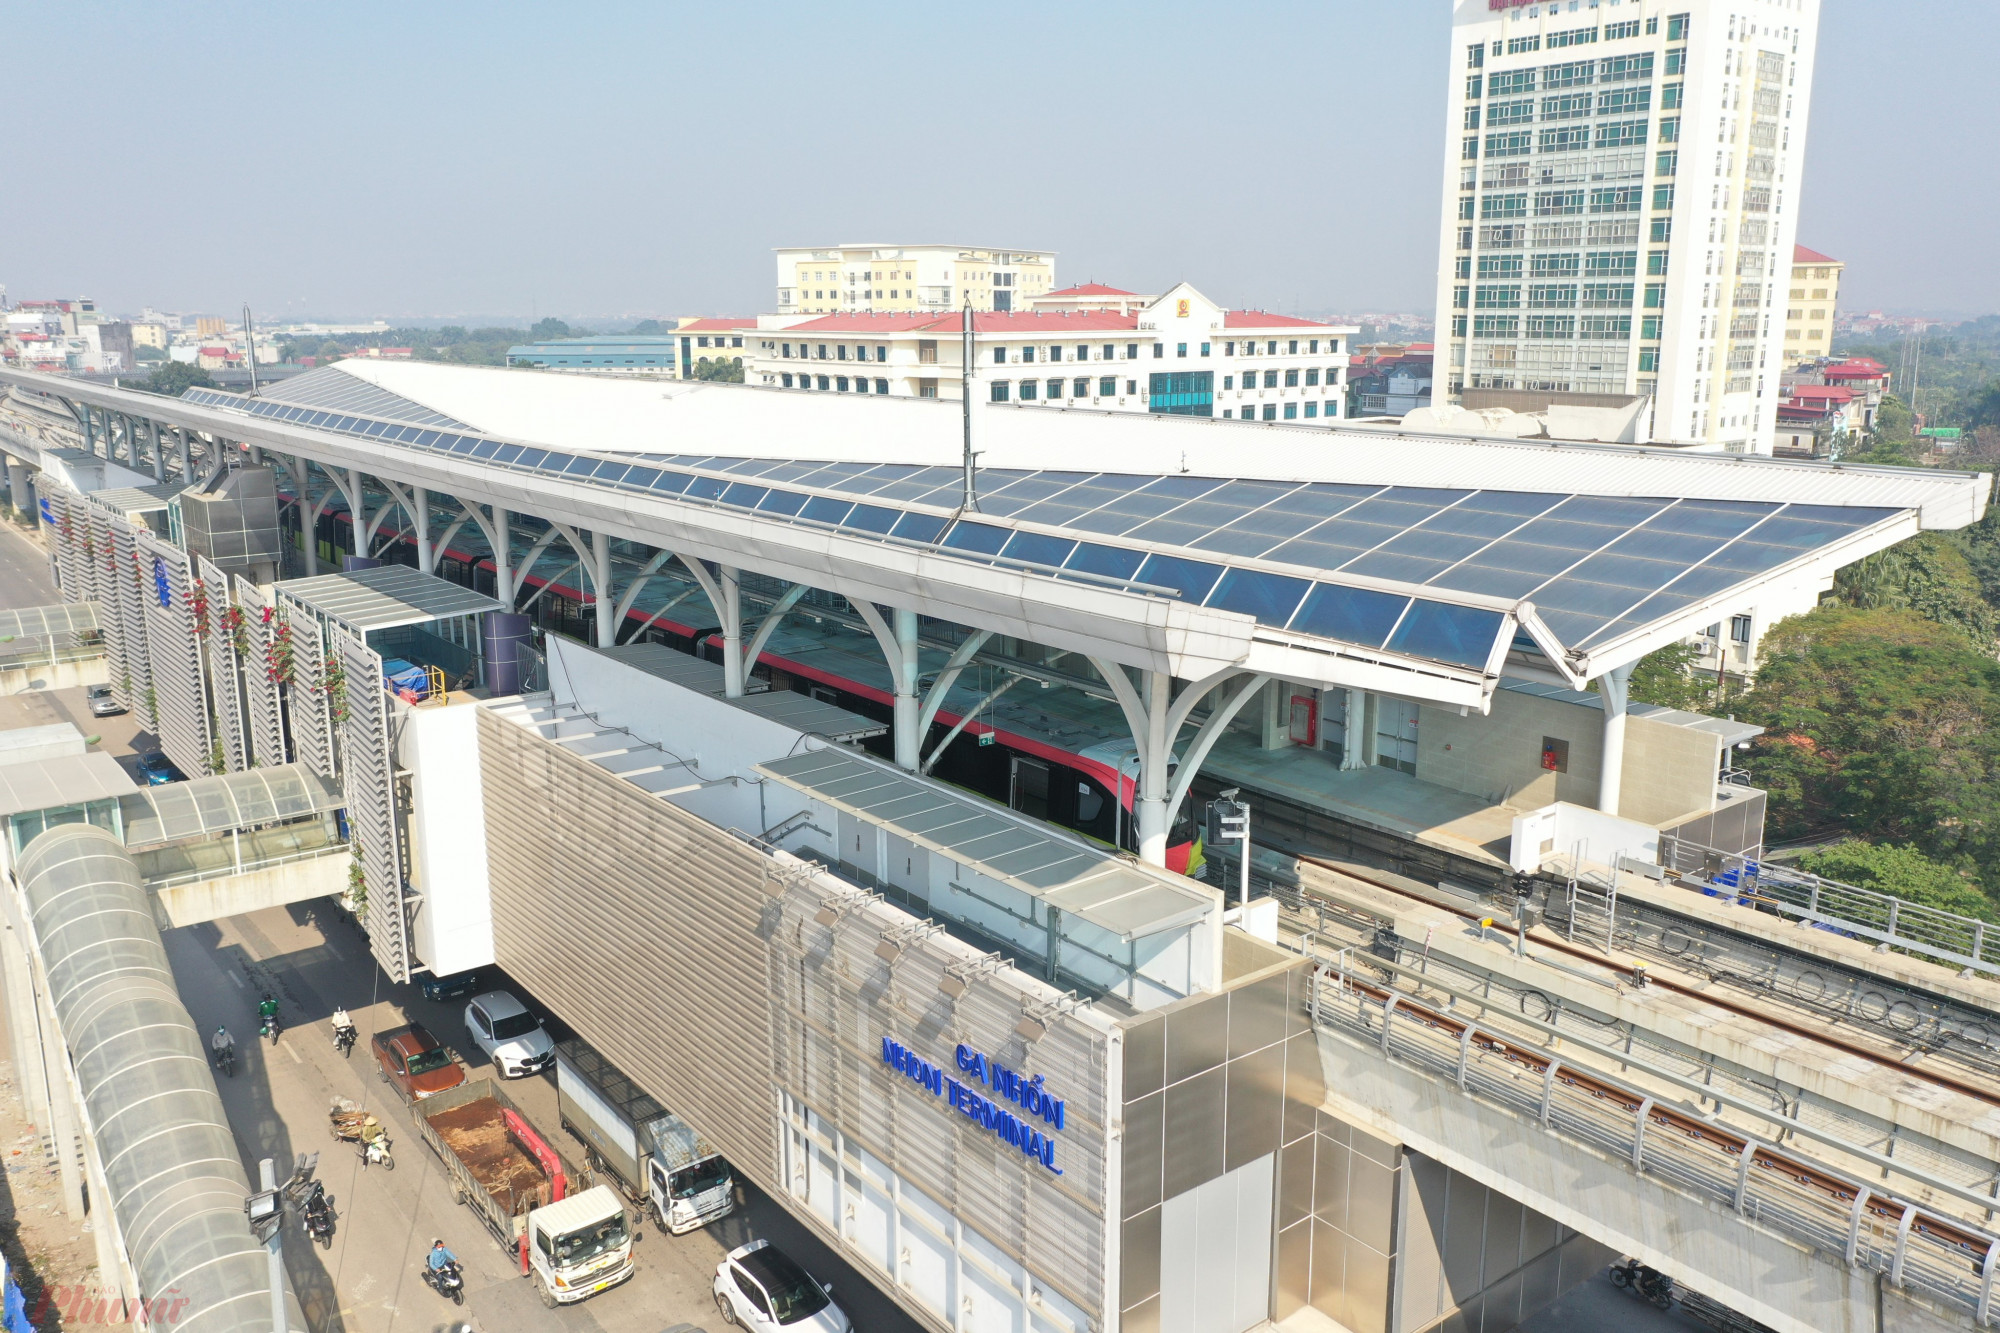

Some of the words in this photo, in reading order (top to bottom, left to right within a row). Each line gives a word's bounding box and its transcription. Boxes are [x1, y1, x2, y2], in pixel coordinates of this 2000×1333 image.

[882, 1035, 942, 1096] NHON
[944, 1074, 1064, 1175] TERMINAL
[956, 1044, 989, 1084] GA
[992, 1063, 1065, 1131] NHỔN
